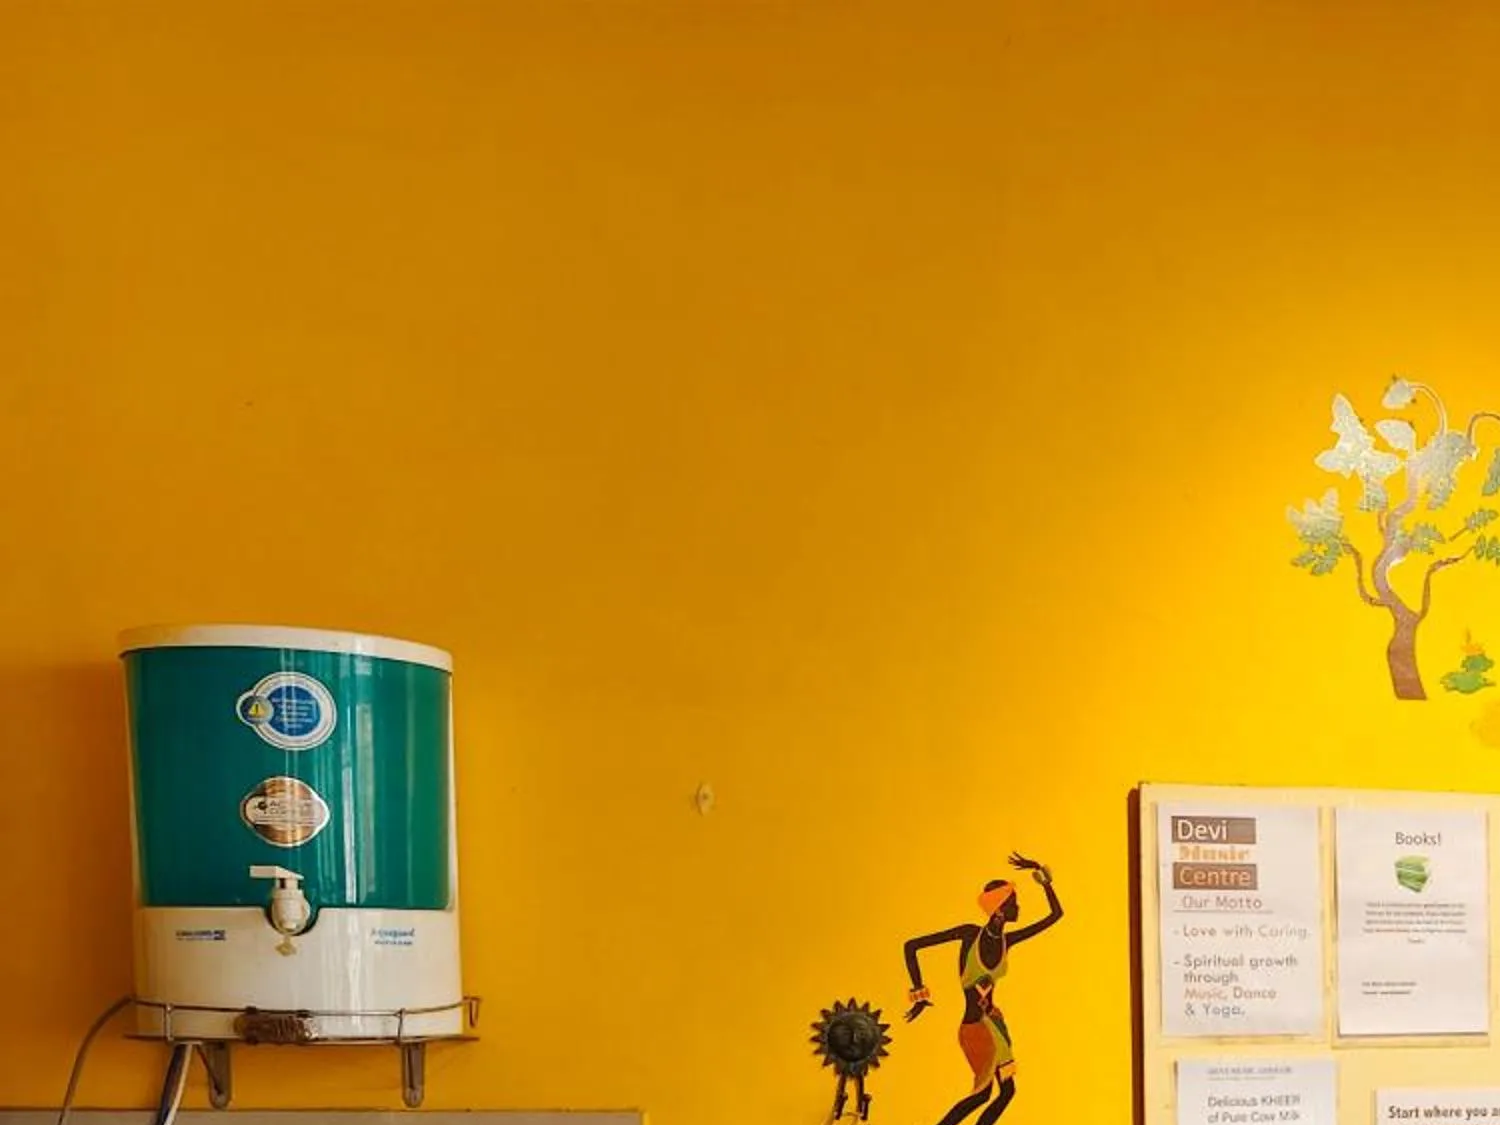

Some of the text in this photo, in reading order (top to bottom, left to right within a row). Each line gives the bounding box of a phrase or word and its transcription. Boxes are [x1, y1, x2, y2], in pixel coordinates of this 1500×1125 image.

[1177, 818, 1228, 841] Devi
[1394, 831, 1441, 846] Books!
[1179, 866, 1252, 887] Centre
[1182, 895, 1263, 909] Our Motto
[1183, 924, 1218, 937] Love
[1222, 924, 1253, 937] with
[1183, 953, 1245, 969] Spiritual
[1248, 955, 1299, 970] growth
[1183, 970, 1239, 986] through
[1232, 985, 1277, 1000] Dance
[1184, 1003, 1195, 1016] &
[1388, 1105, 1420, 1119] Start
[1423, 1105, 1464, 1119] where
[1465, 1107, 1488, 1121] you
